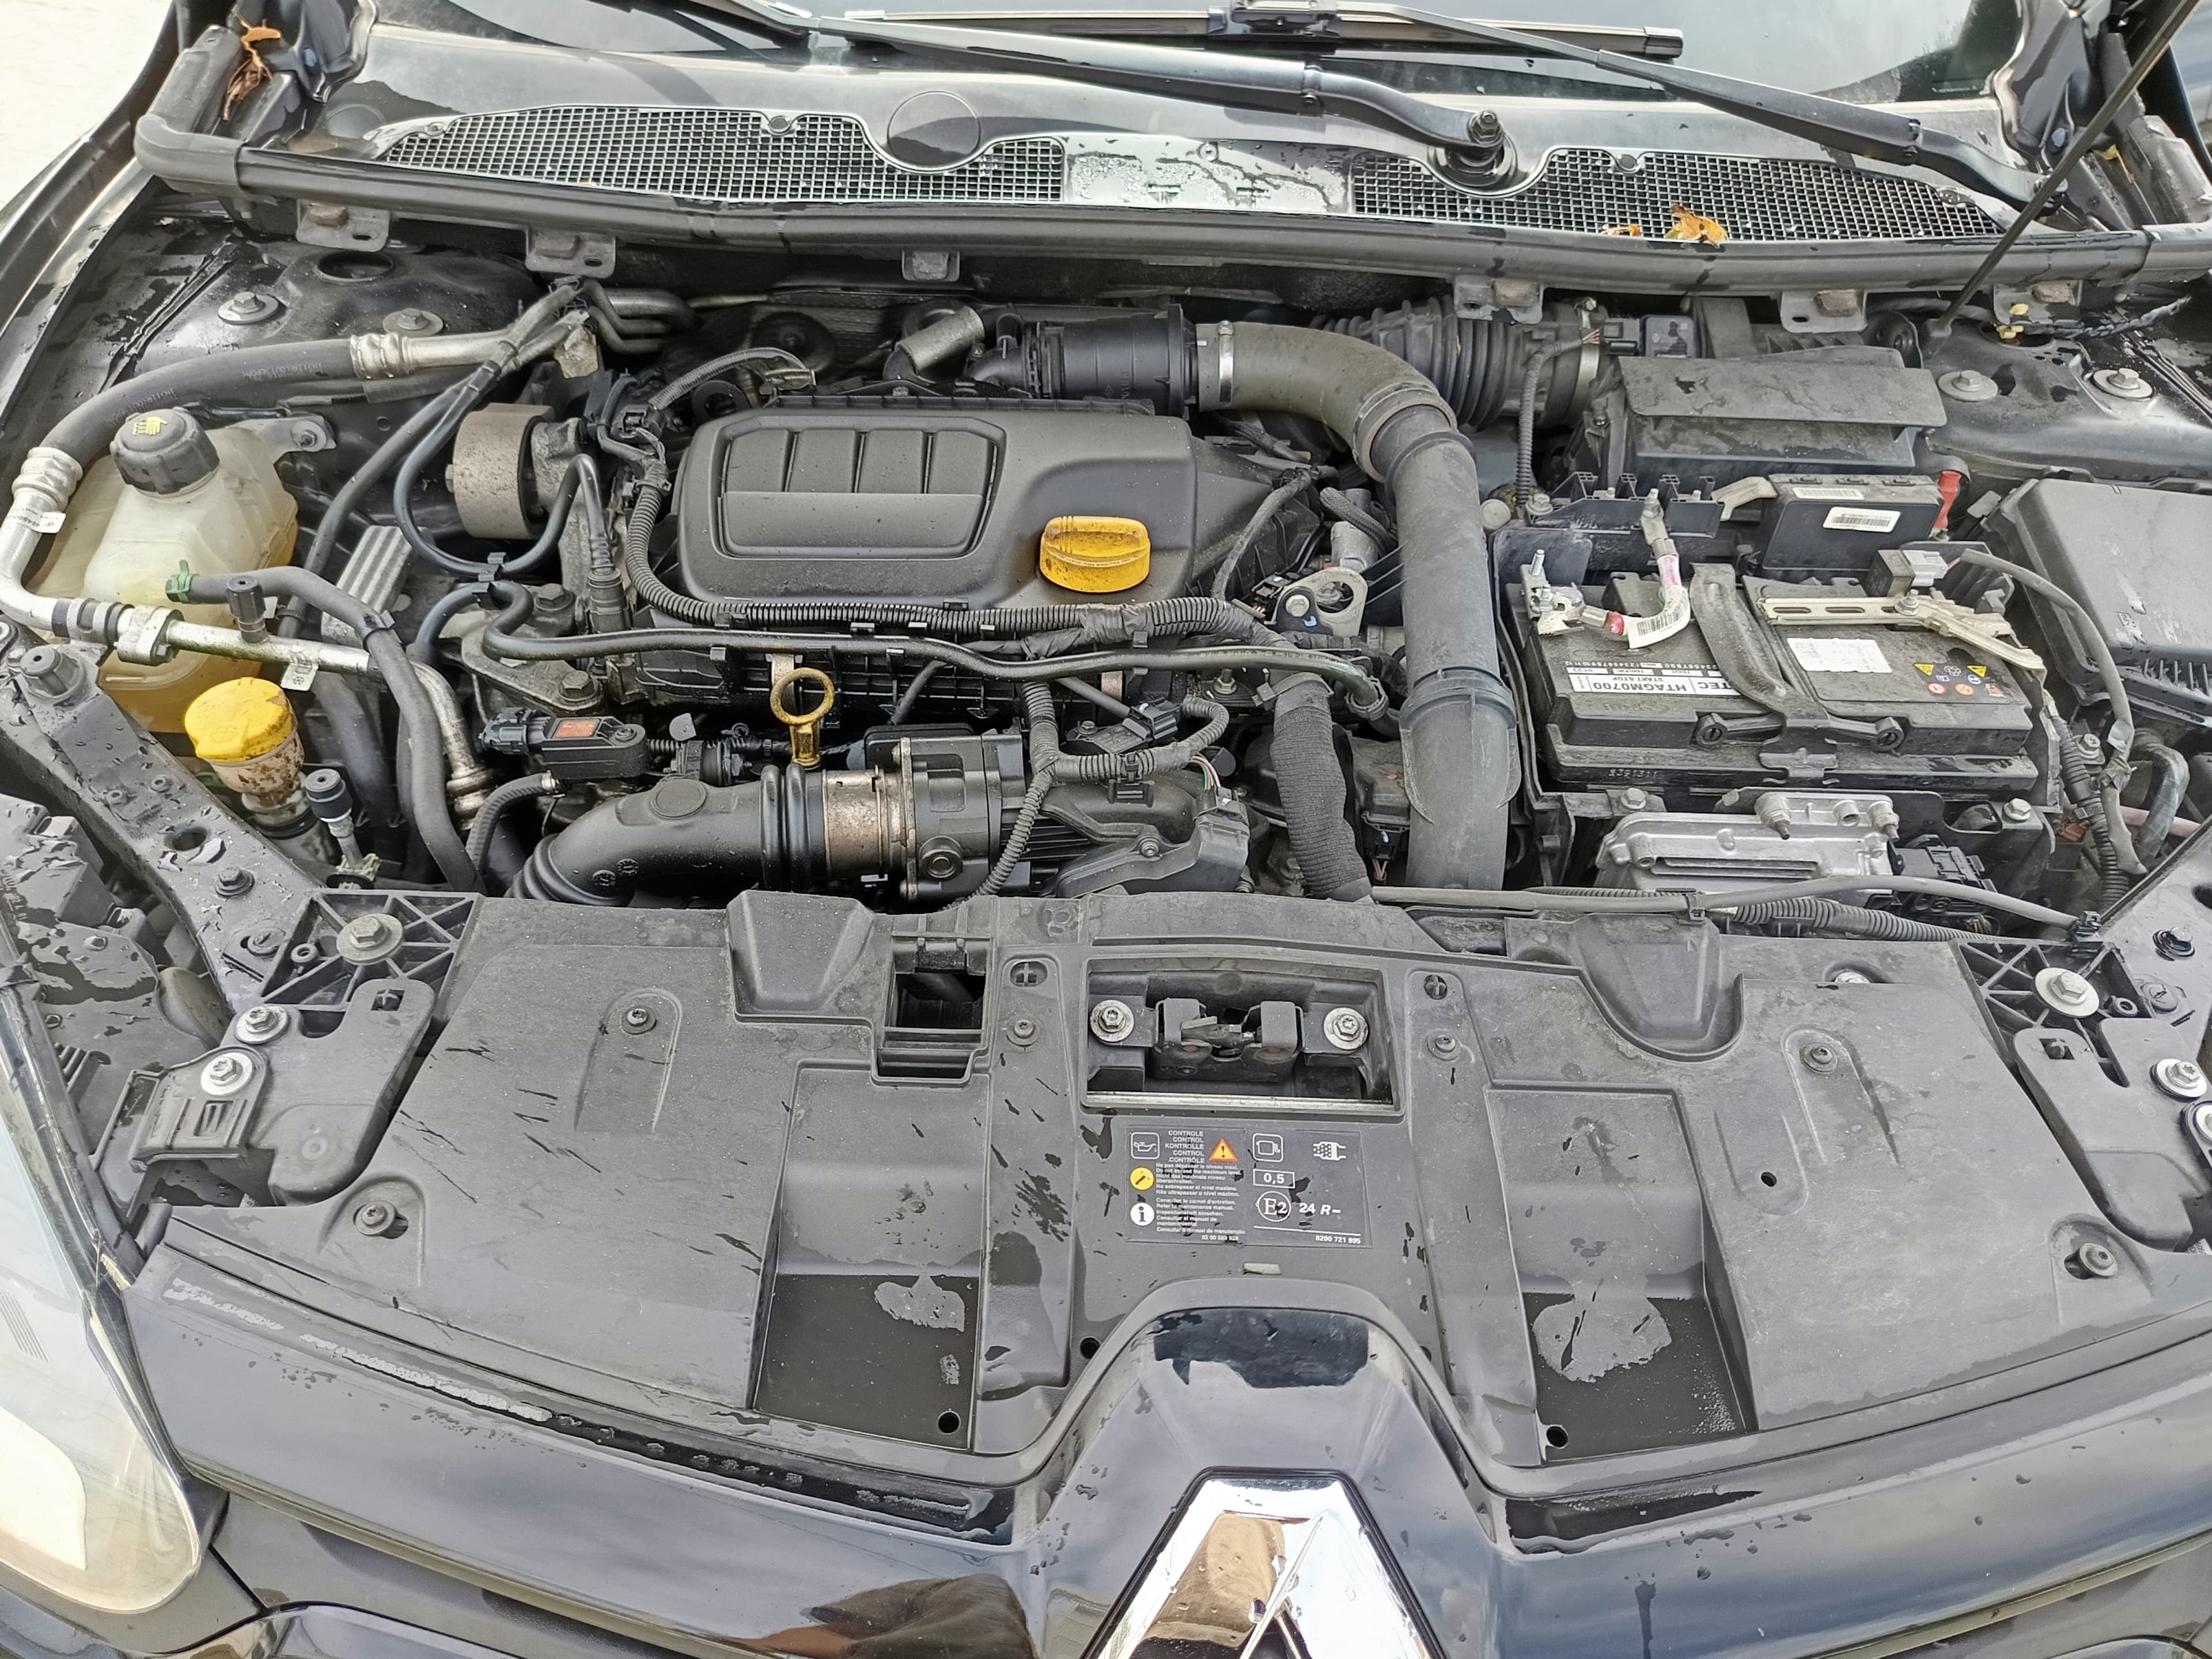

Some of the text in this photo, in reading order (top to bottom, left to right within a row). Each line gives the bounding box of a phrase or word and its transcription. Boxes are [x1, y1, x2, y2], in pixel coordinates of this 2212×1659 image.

[1593, 681, 1687, 691] HTAGM0700
[1264, 1173, 1285, 1184] 0,5
[1263, 1198, 1287, 1215] E2
[1299, 1203, 1316, 1214] 24
